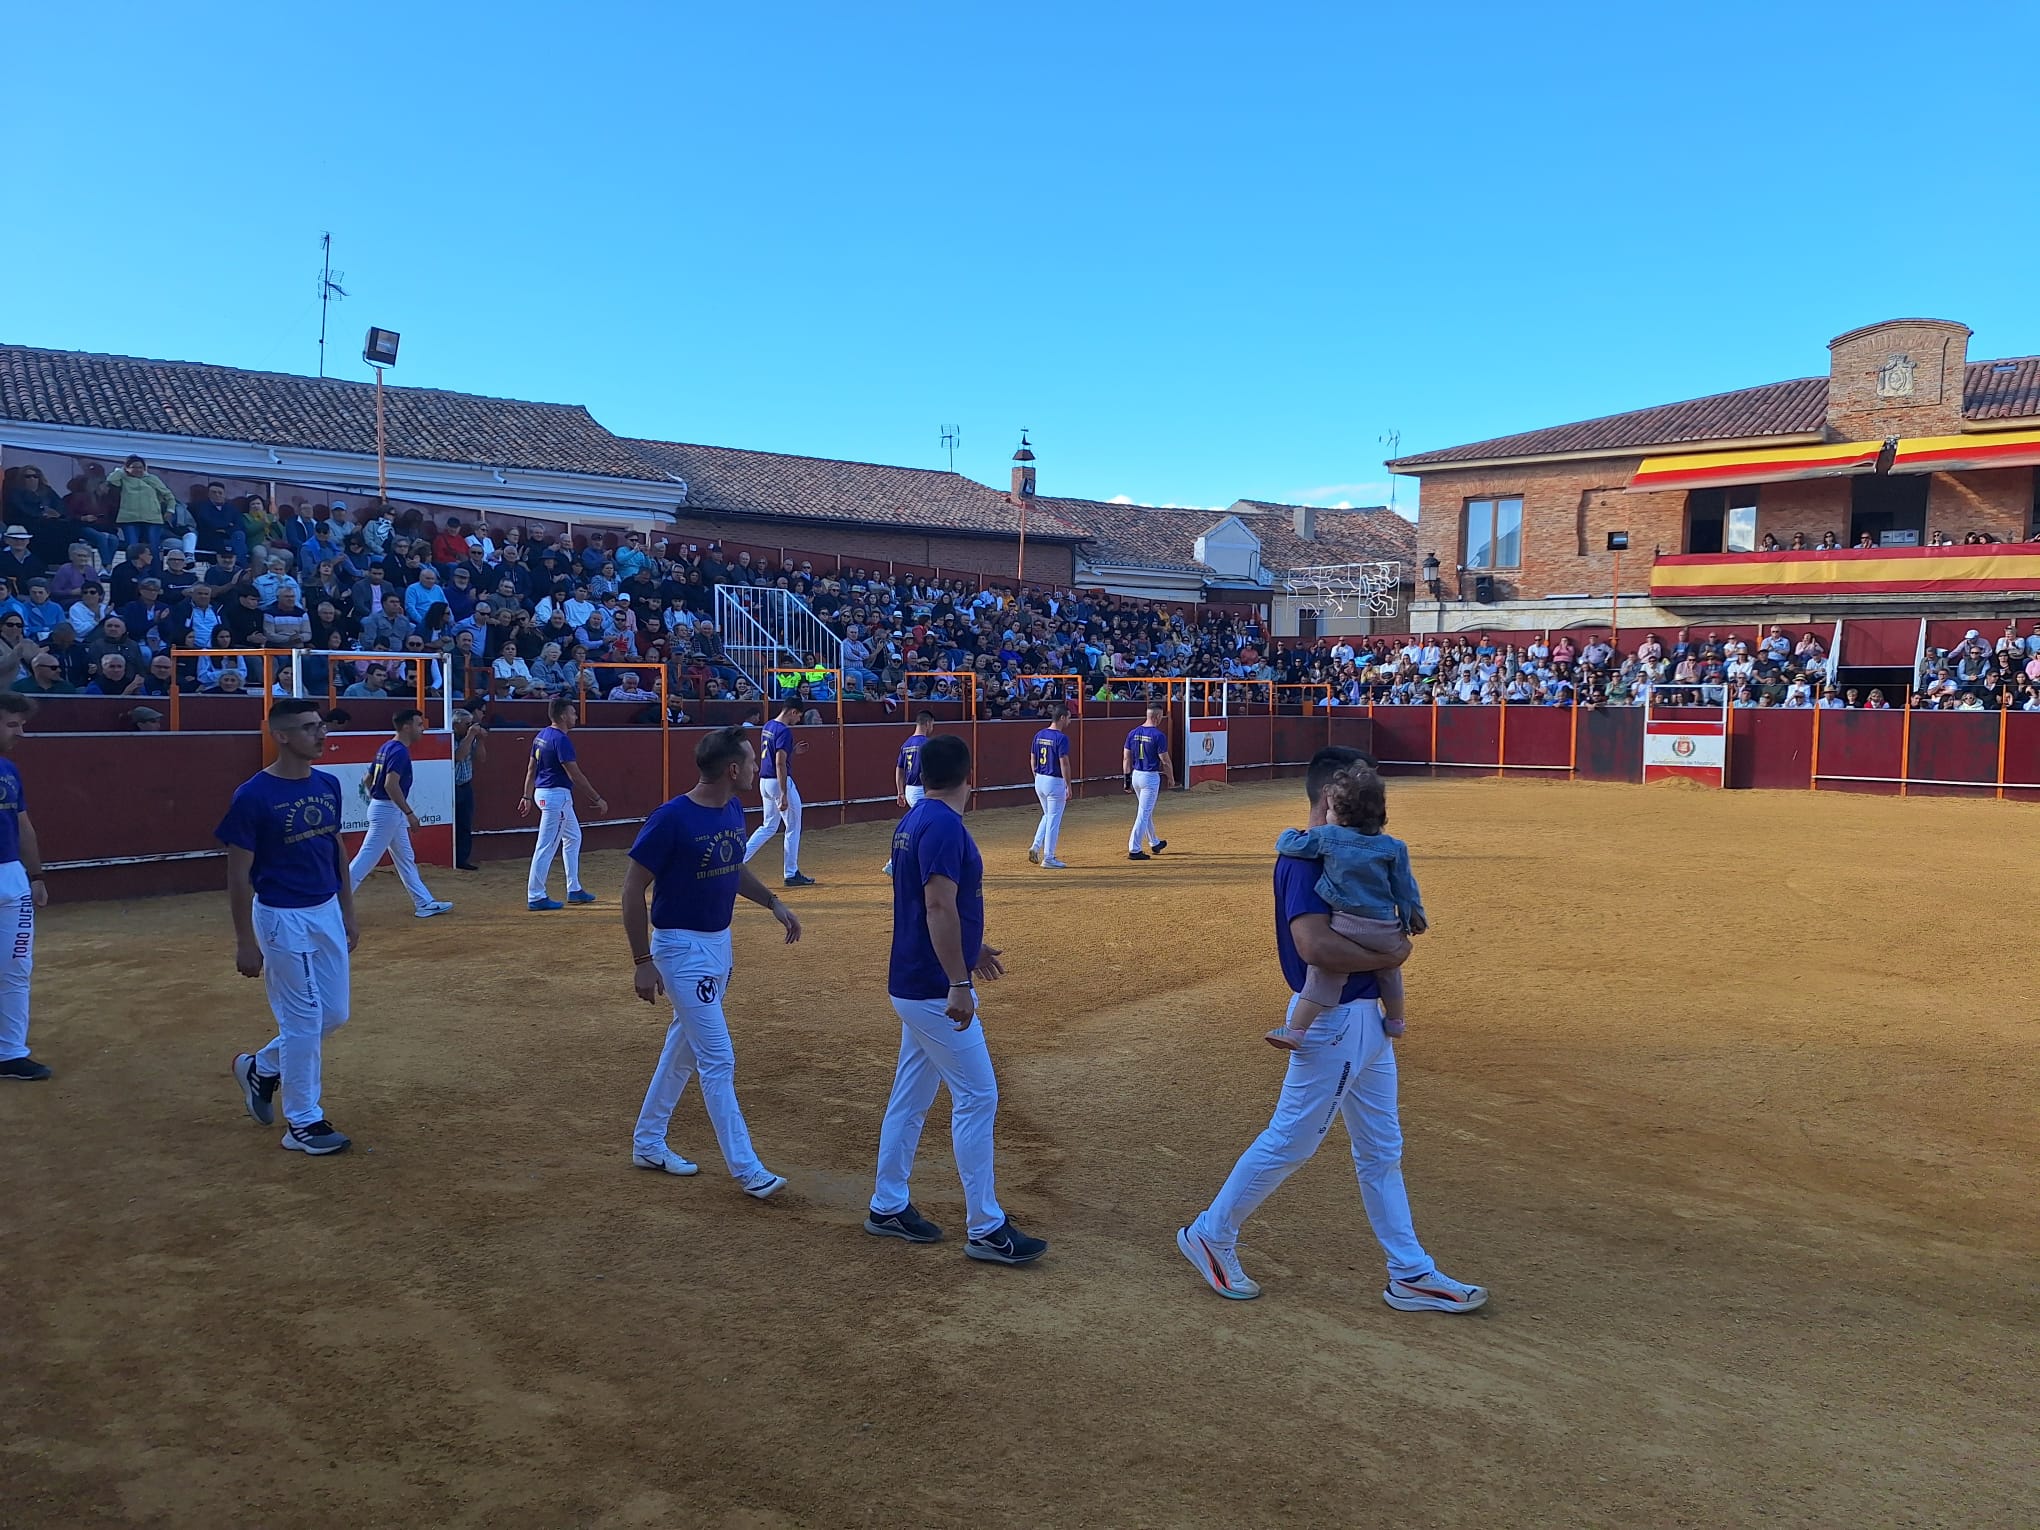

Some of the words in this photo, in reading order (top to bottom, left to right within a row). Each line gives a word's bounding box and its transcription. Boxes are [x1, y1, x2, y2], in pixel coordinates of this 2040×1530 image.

[1039, 747, 1048, 765] 3
[1138, 743, 1144, 760] 1
[294, 798, 306, 808] DE
[713, 831, 724, 842] DE
[18, 894, 33, 929] DUERO
[12, 932, 30, 959] TORO
